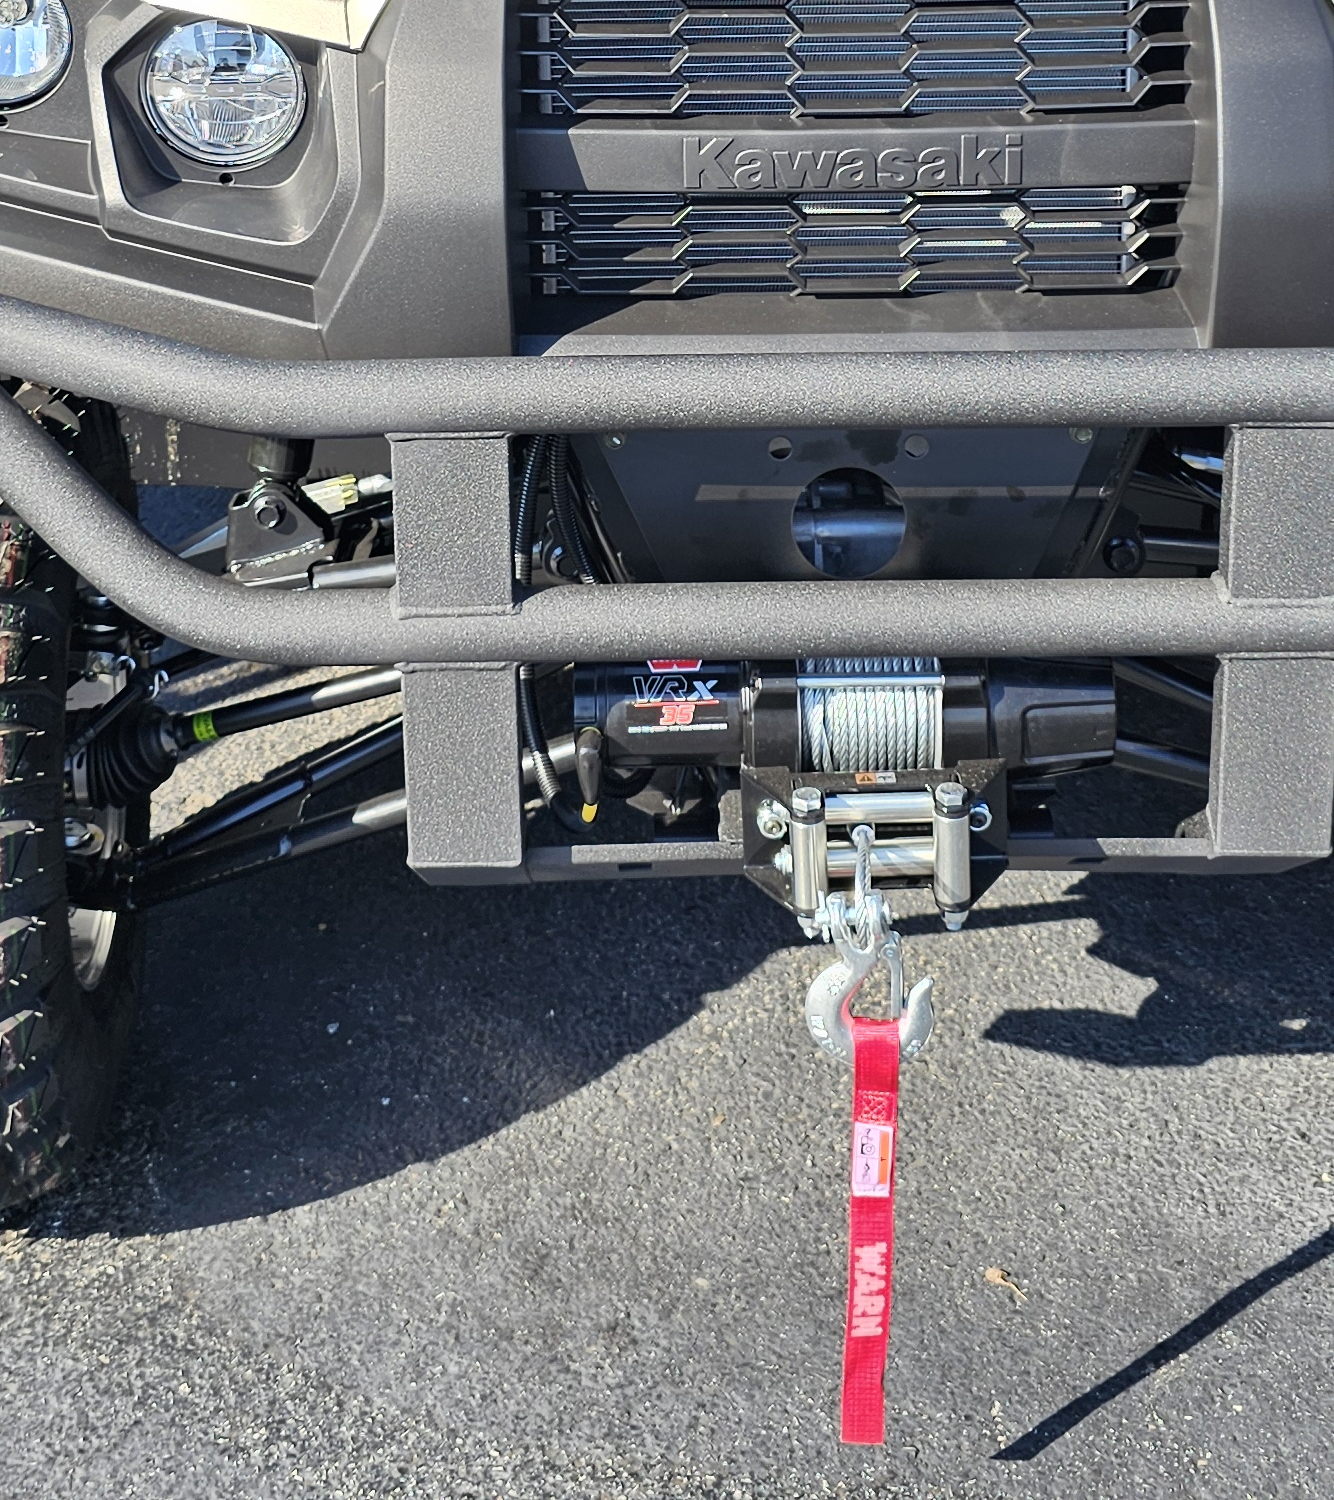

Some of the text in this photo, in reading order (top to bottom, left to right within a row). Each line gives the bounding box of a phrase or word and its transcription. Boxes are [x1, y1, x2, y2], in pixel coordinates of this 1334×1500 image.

[683, 134, 1024, 190] Kawasaki
[659, 704, 696, 726] 35
[850, 1241, 888, 1338] WARN
